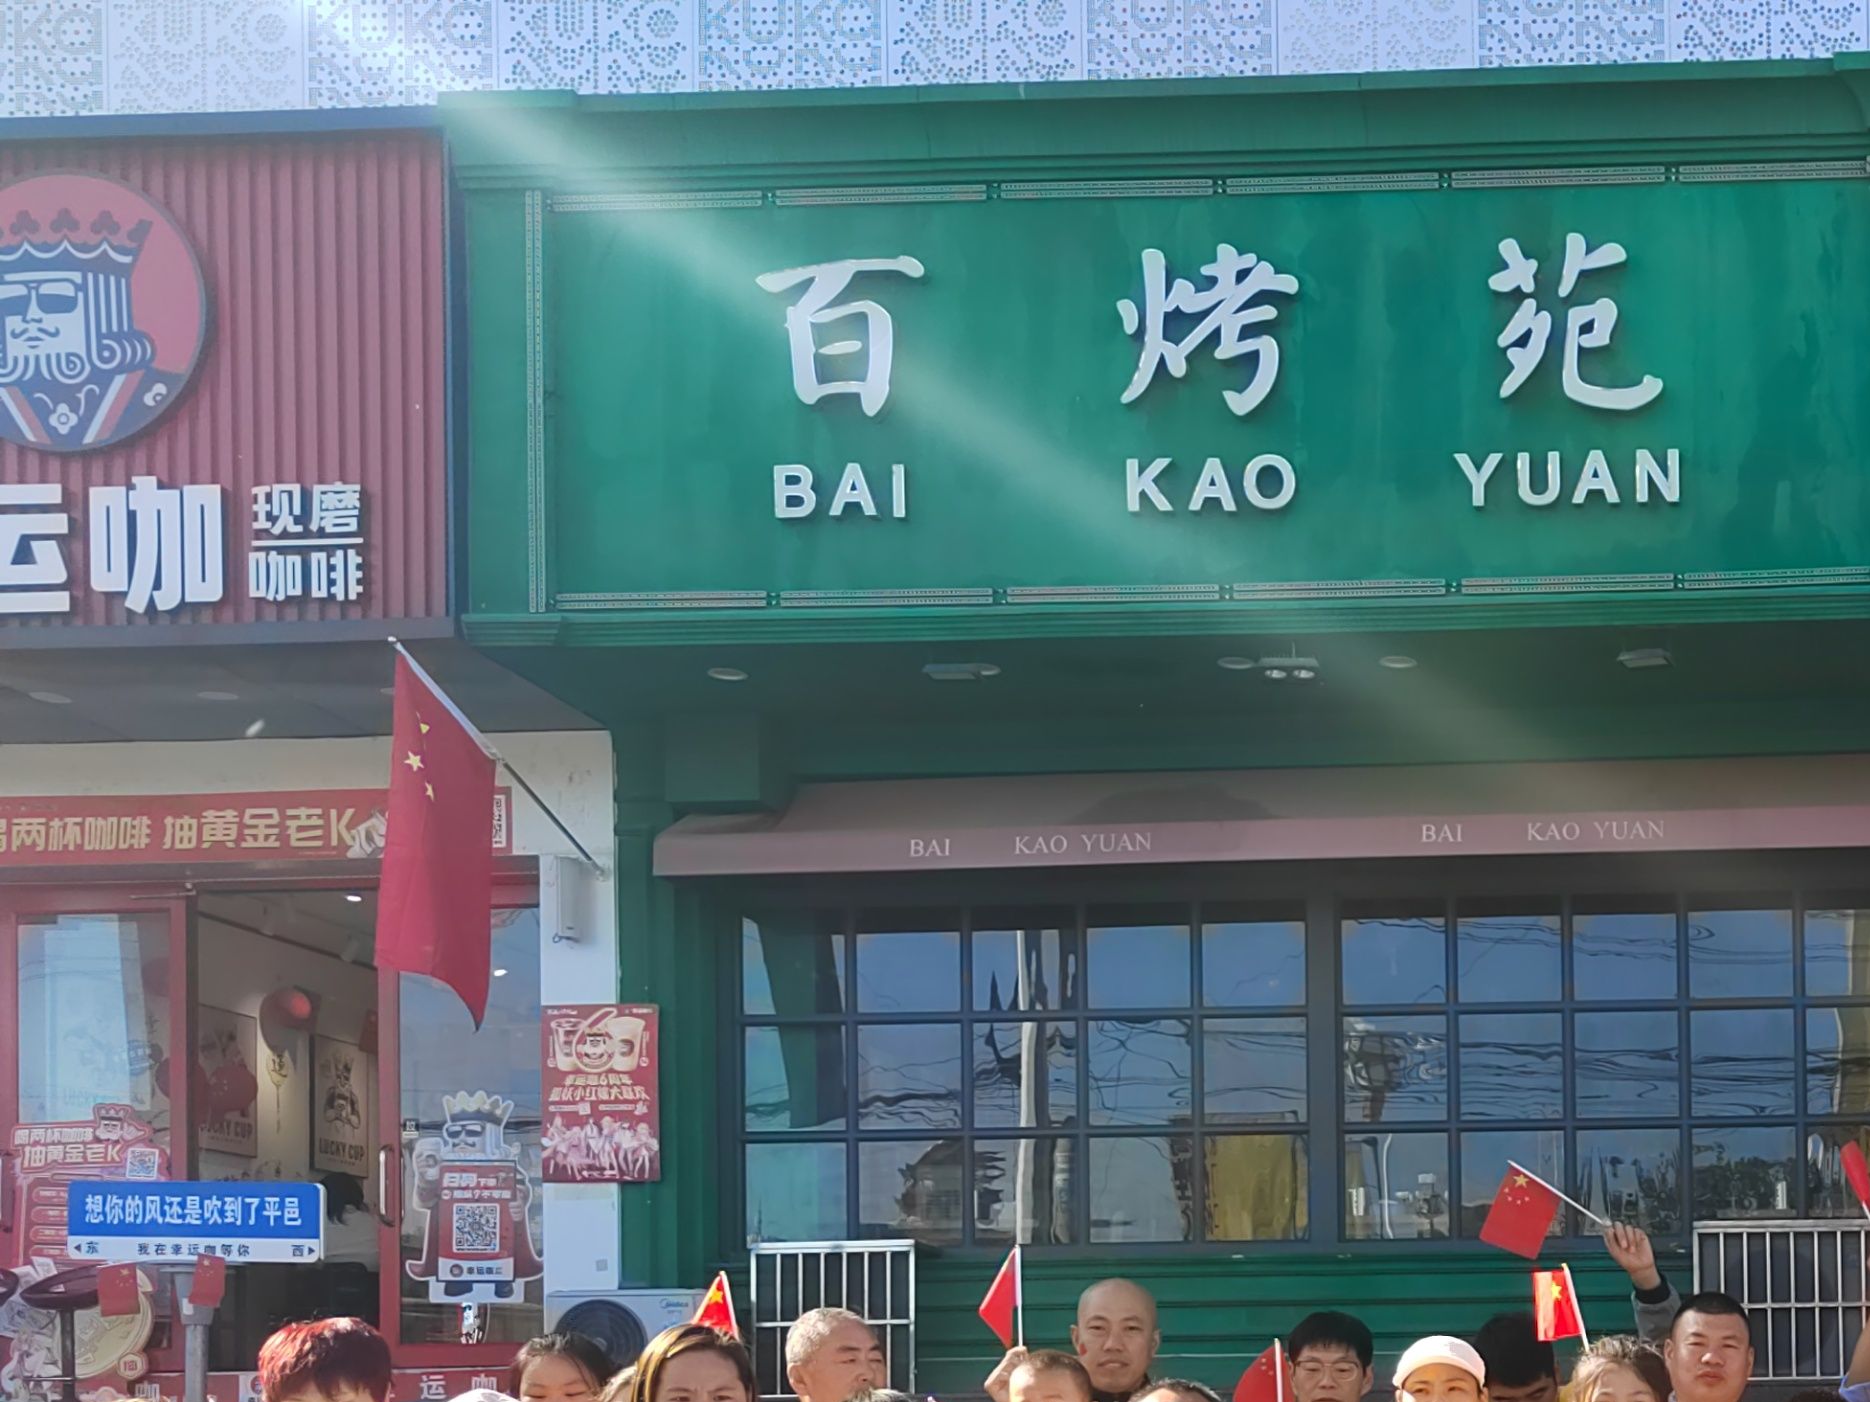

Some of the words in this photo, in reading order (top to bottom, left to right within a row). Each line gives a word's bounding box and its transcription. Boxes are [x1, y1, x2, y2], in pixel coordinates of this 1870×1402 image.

[755, 231, 1664, 417] 百烤苑
[772, 460, 908, 520] BAI
[1124, 452, 1298, 514] KAO
[1453, 447, 1683, 508] YUAN
[251, 481, 362, 536] 现磨
[248, 549, 364, 602] 咖啡
[0, 815, 151, 853] 两杯咖啡
[162, 806, 356, 850] 抽黄金老K
[909, 837, 952, 857] BAI
[1013, 833, 1068, 856] KAO
[1081, 831, 1153, 855] YUAN
[1420, 822, 1464, 844] BAI
[1526, 820, 1581, 843] KAO
[1593, 818, 1666, 841] YUAN
[85, 1194, 302, 1227] 想你的风还是吹到了平邑
[292, 1244, 304, 1257] 西
